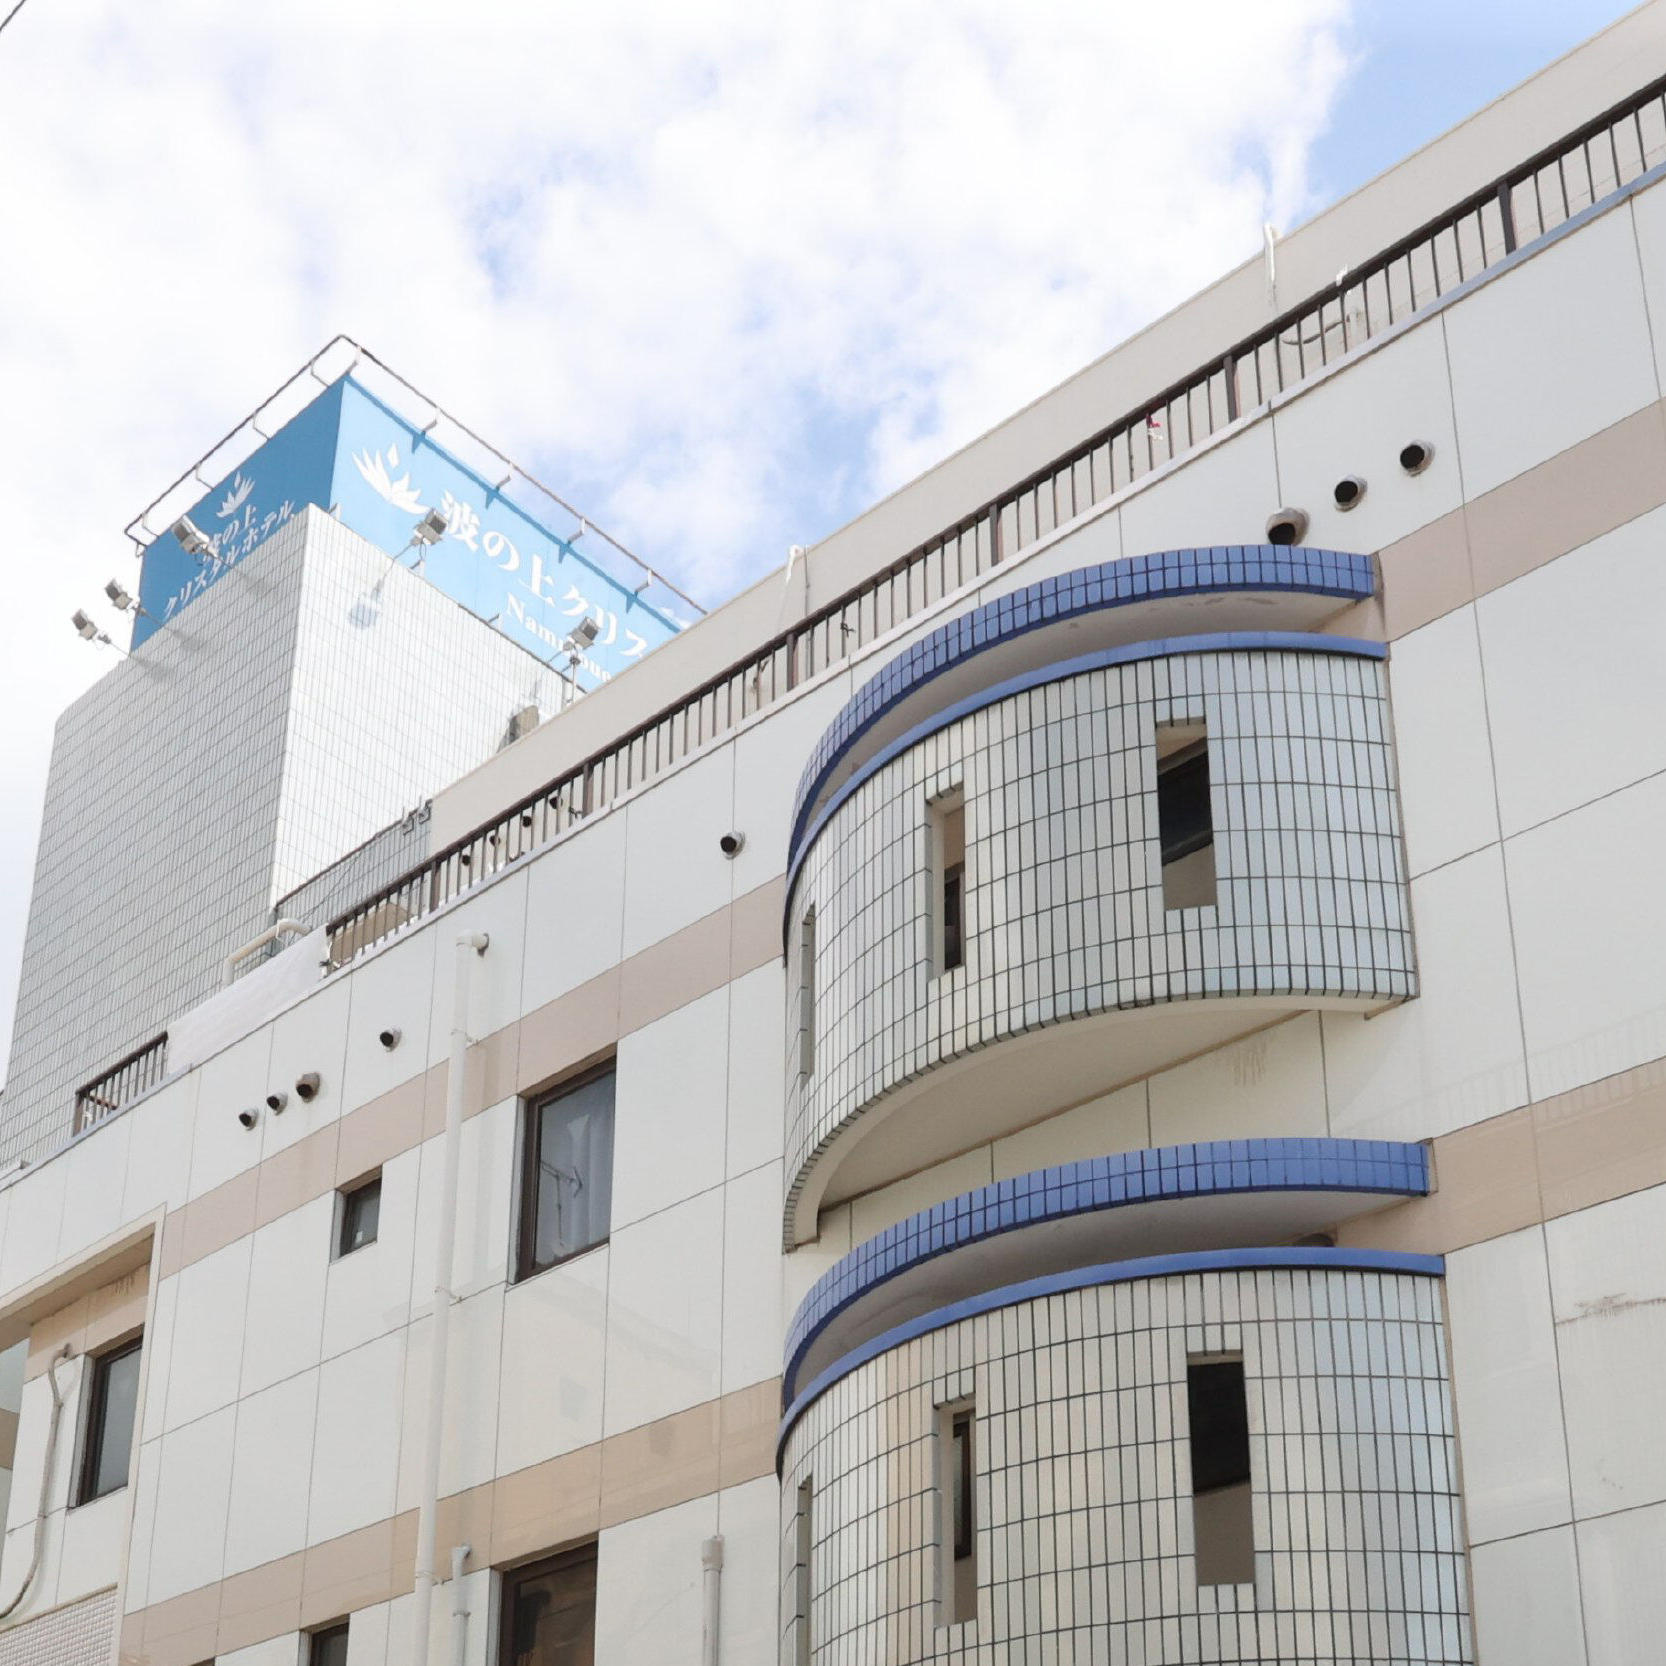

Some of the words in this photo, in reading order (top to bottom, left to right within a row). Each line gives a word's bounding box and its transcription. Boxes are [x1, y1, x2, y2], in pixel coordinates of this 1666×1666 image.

[164, 500, 295, 622] クリスタルホテル
